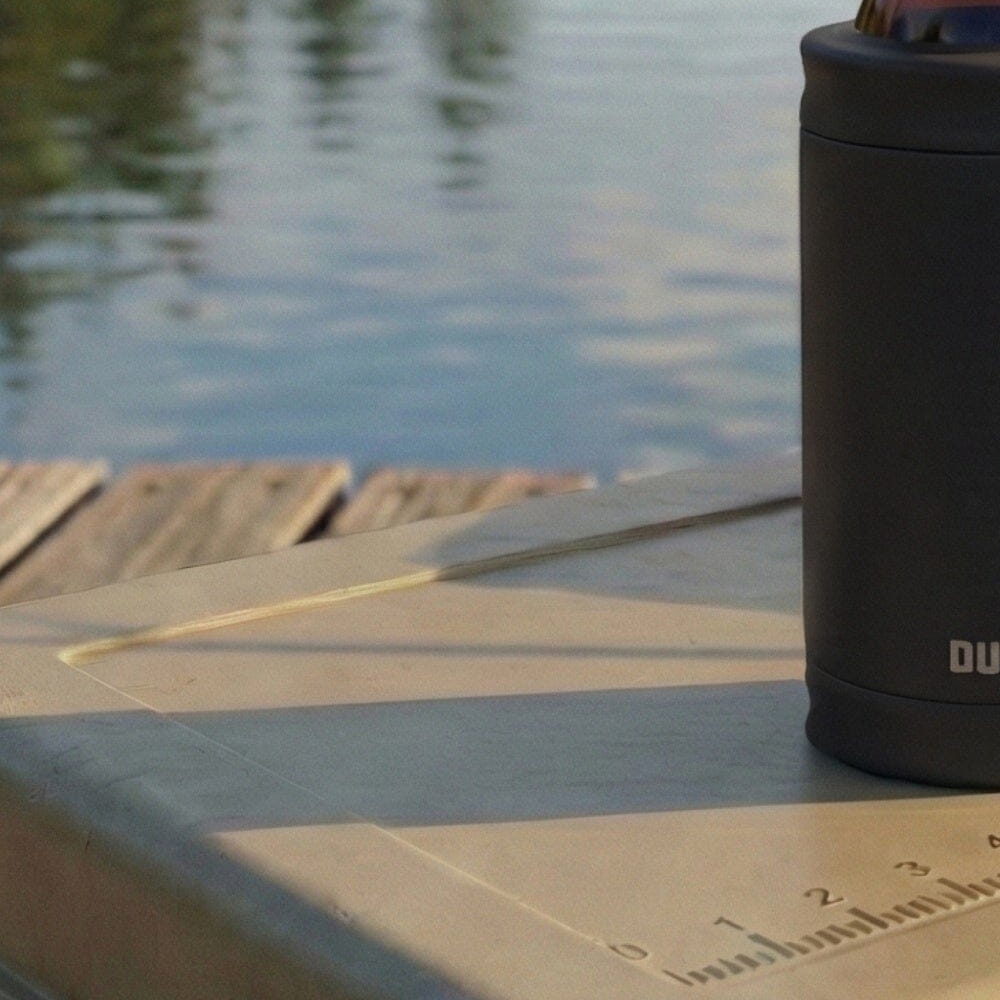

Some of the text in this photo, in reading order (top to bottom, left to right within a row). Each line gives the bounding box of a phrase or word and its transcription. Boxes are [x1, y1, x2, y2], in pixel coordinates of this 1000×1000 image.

[713, 916, 744, 931] 1
[804, 887, 844, 907] 2
[895, 861, 931, 877] 3
